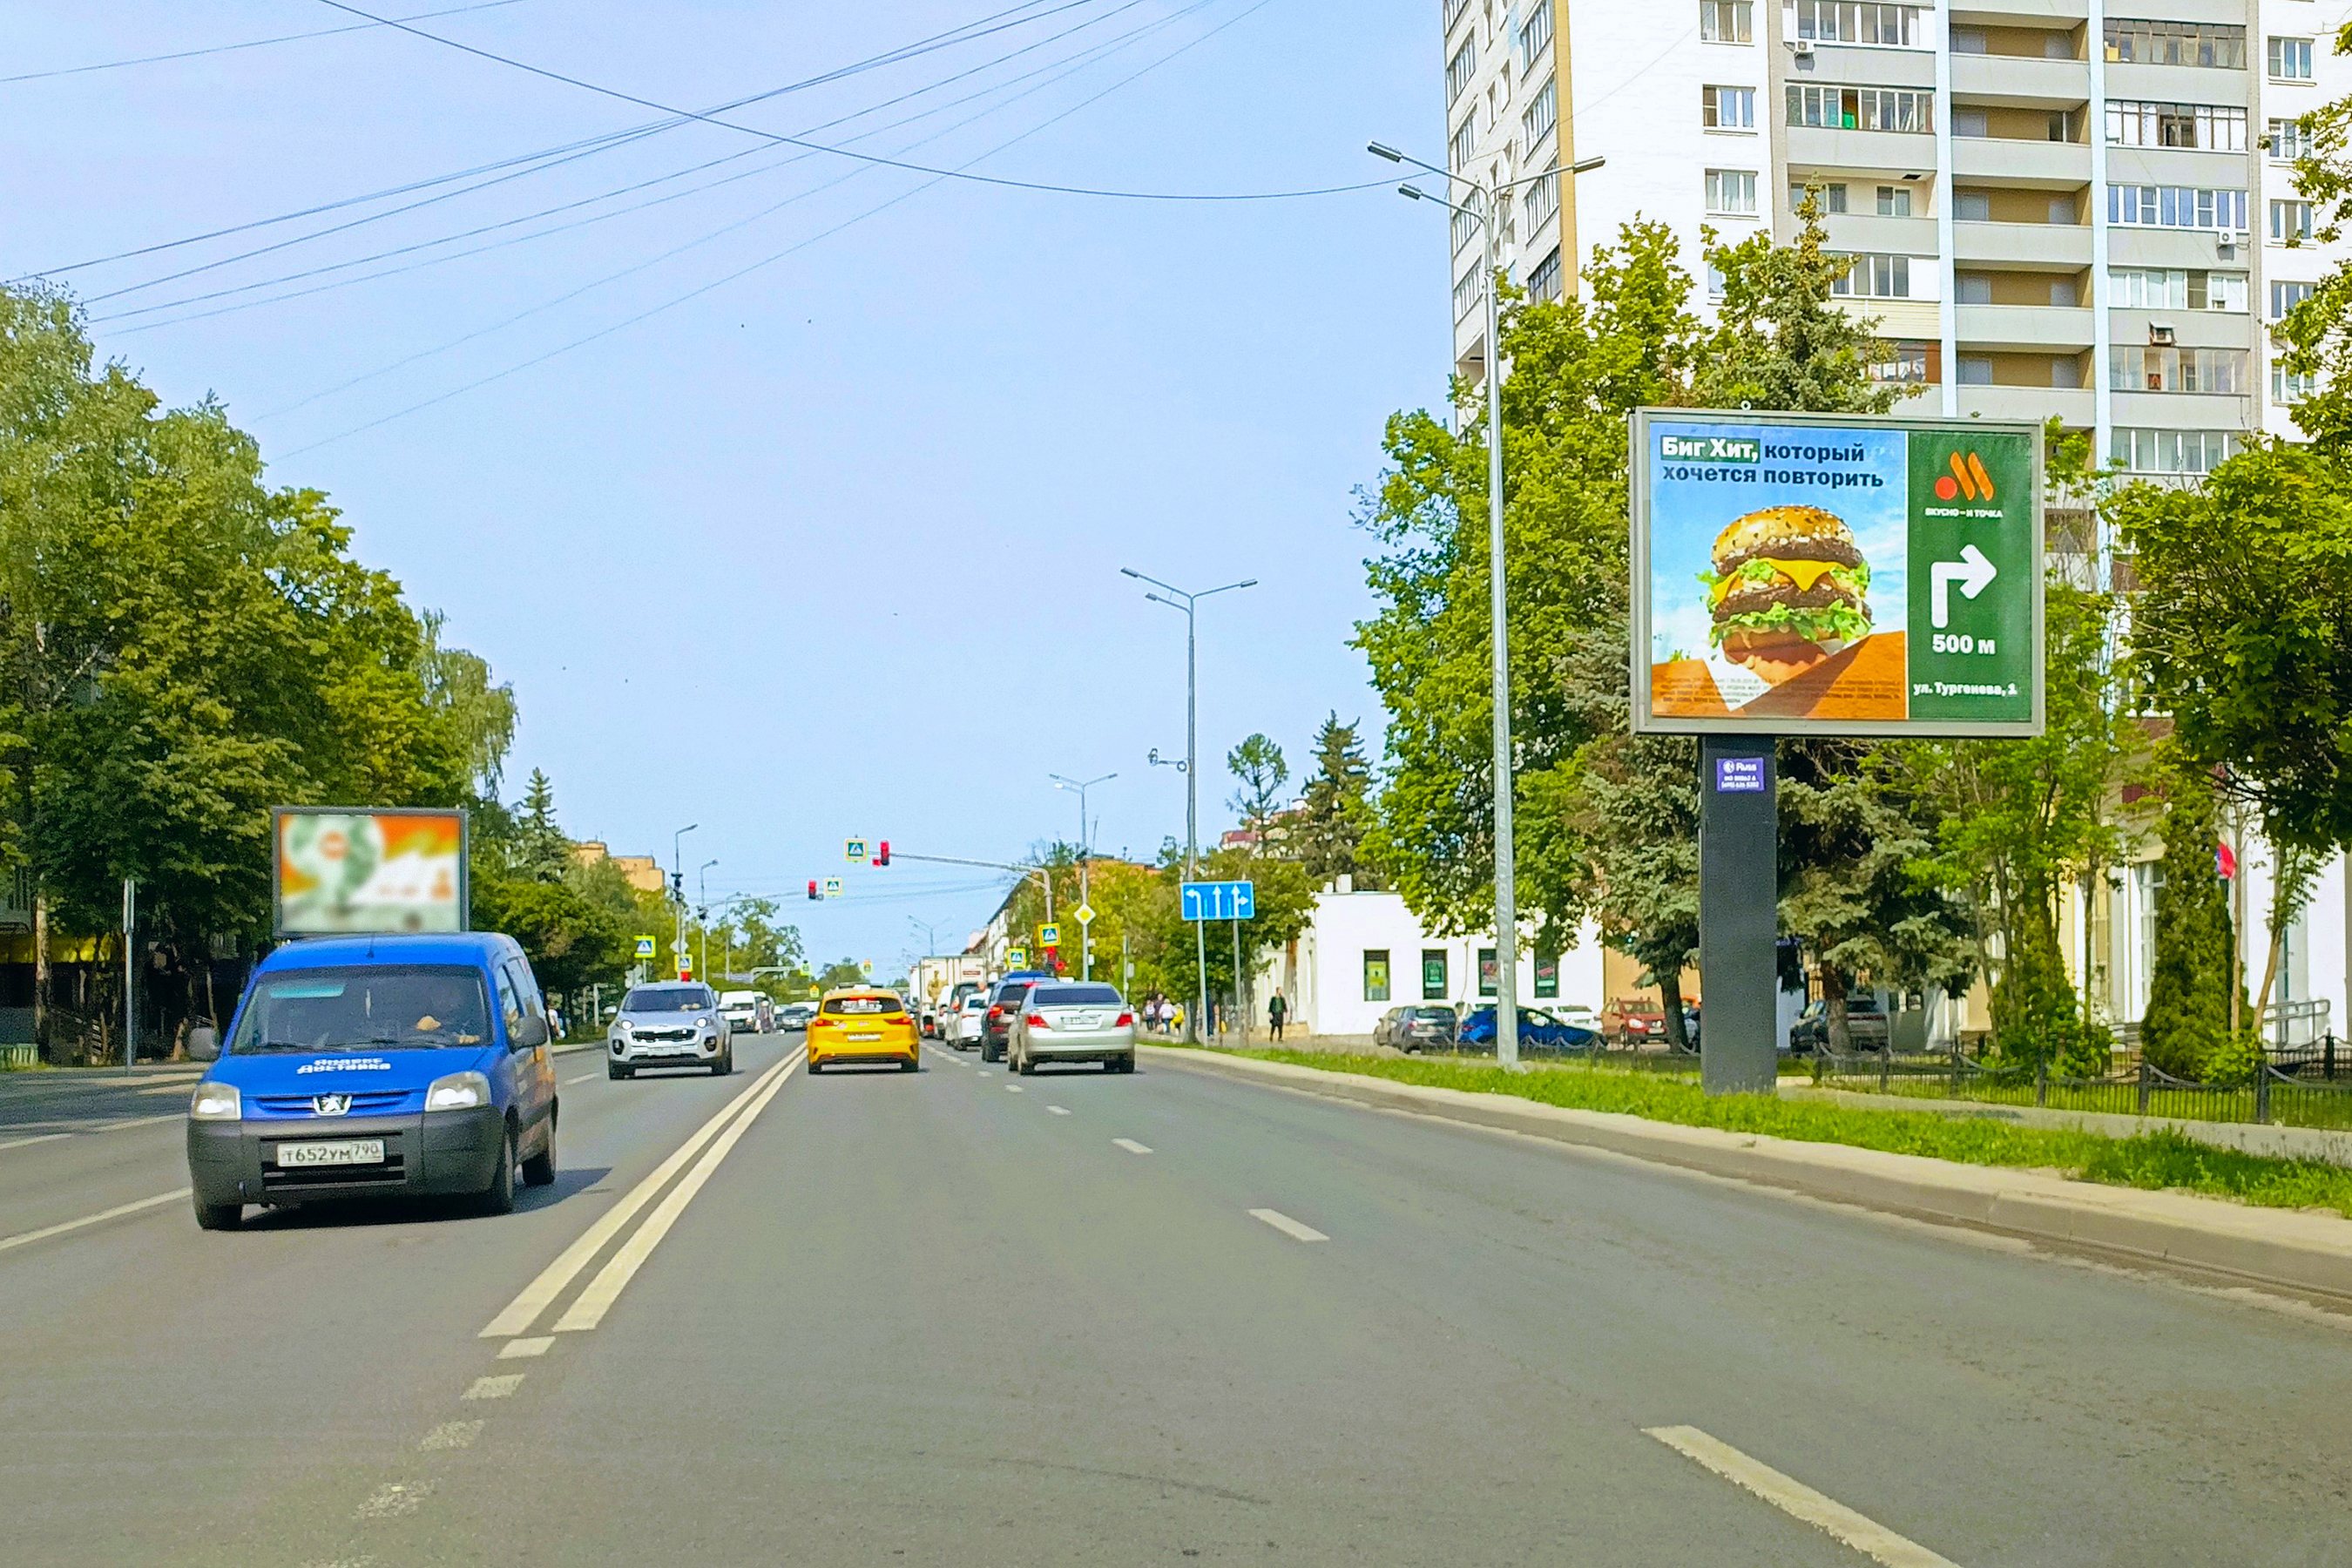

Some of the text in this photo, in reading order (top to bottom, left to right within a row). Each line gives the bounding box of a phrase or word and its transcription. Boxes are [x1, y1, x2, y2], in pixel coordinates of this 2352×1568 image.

[1662, 436, 1864, 463] Биг Хит, который
[1663, 466, 1883, 489] хочется повторить
[1932, 634, 1997, 654] 500 м
[1913, 683, 1934, 696] ул.
[1934, 681, 2007, 697] Тургенева,
